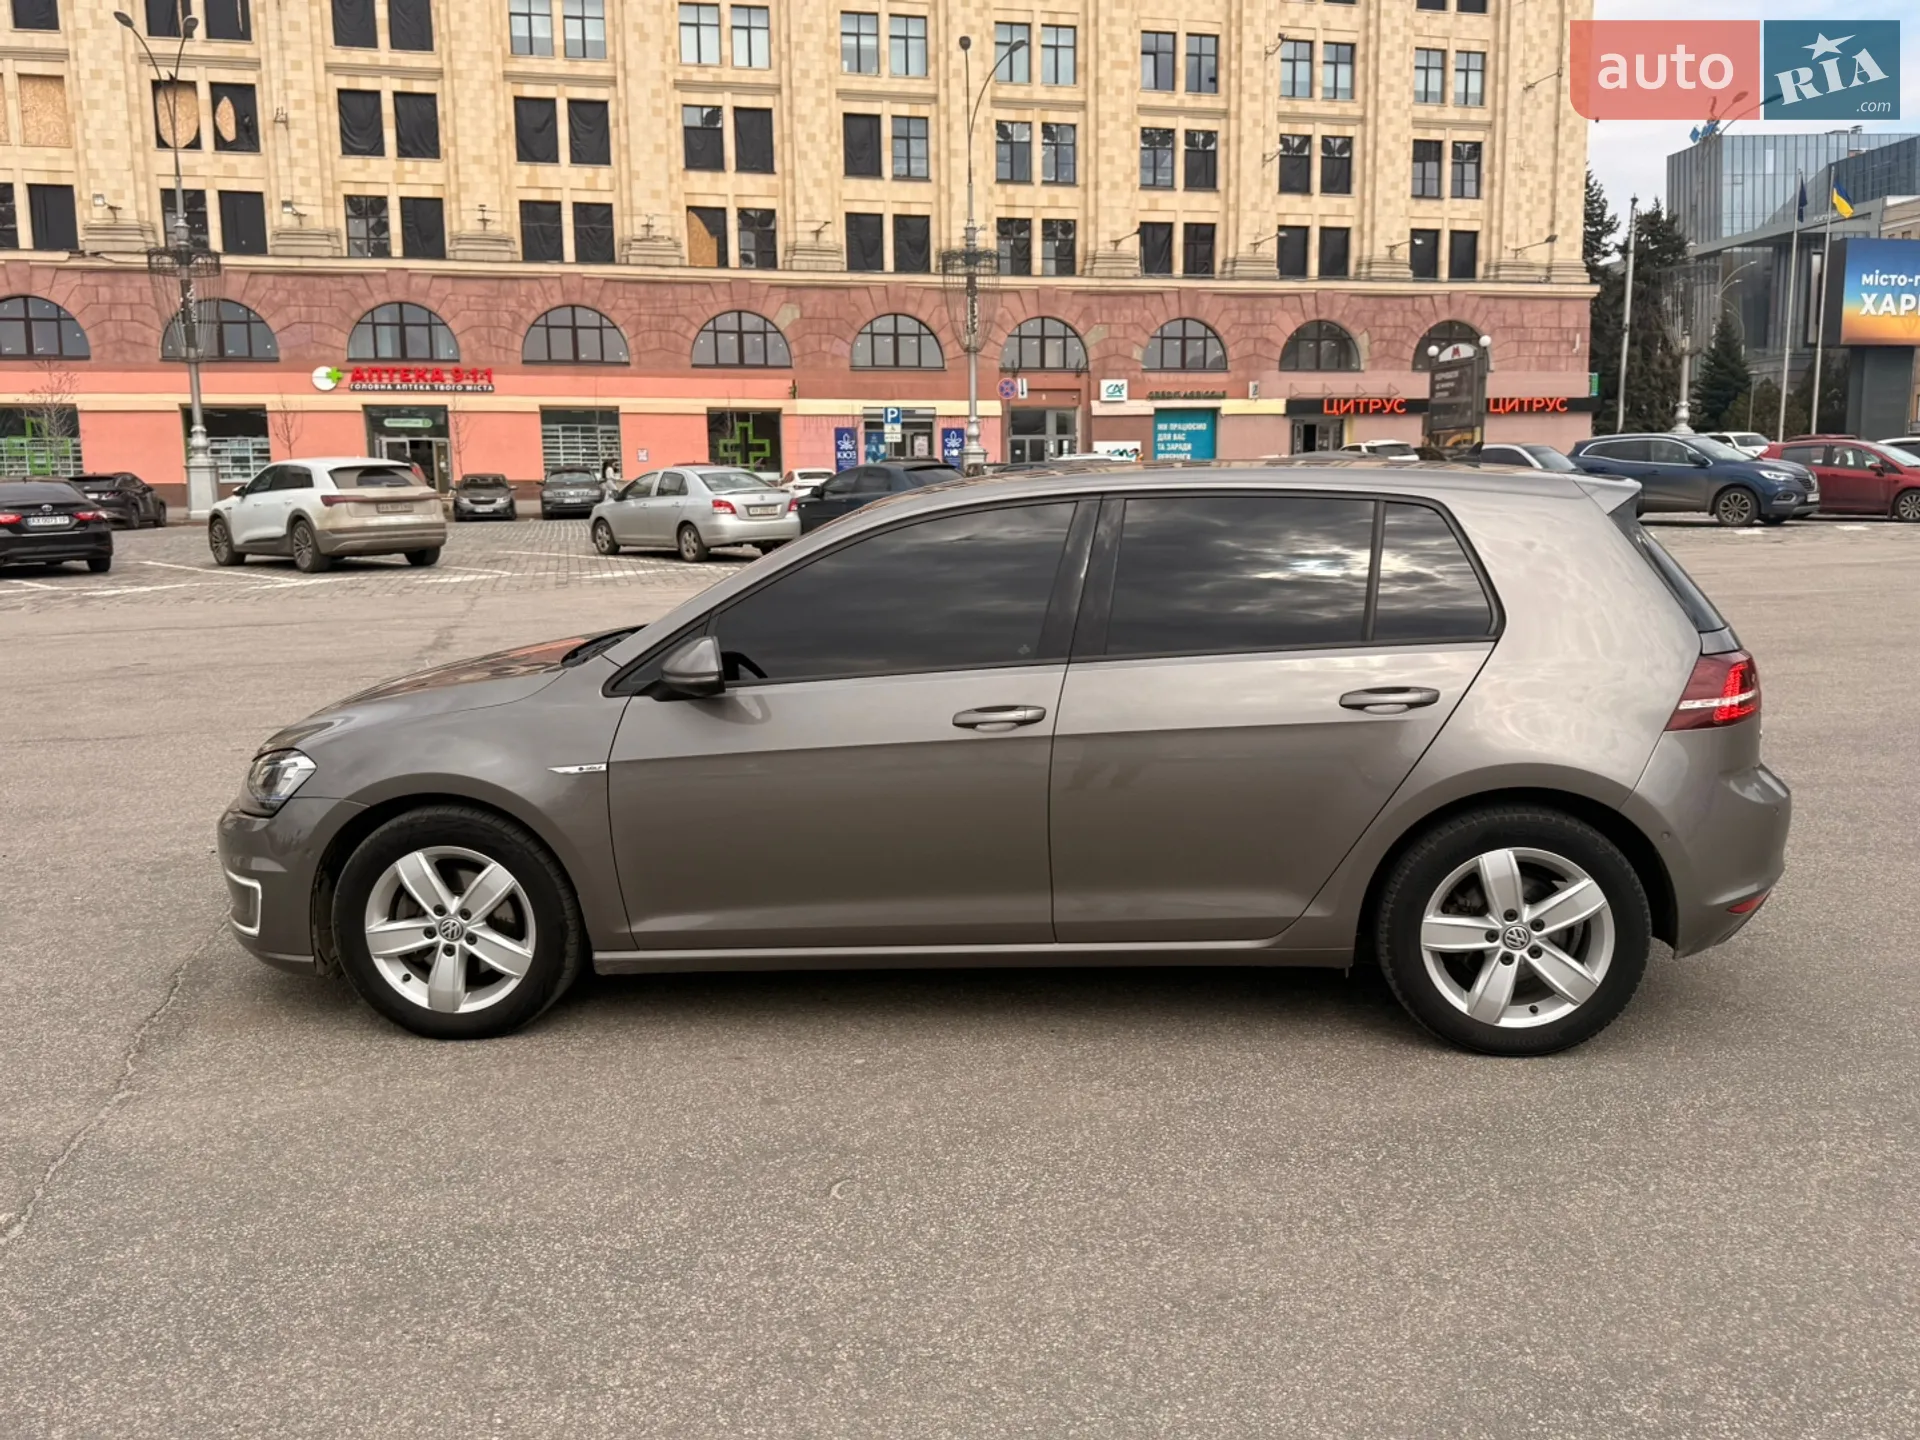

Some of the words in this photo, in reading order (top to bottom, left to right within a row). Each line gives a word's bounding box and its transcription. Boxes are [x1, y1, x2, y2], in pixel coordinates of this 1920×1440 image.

[1860, 292, 1920, 316] ХАР
[351, 367, 445, 383] АПТЕКА
[1323, 398, 1407, 415] ЦИТРУС
[1489, 397, 1568, 414] ЦИТРУС
